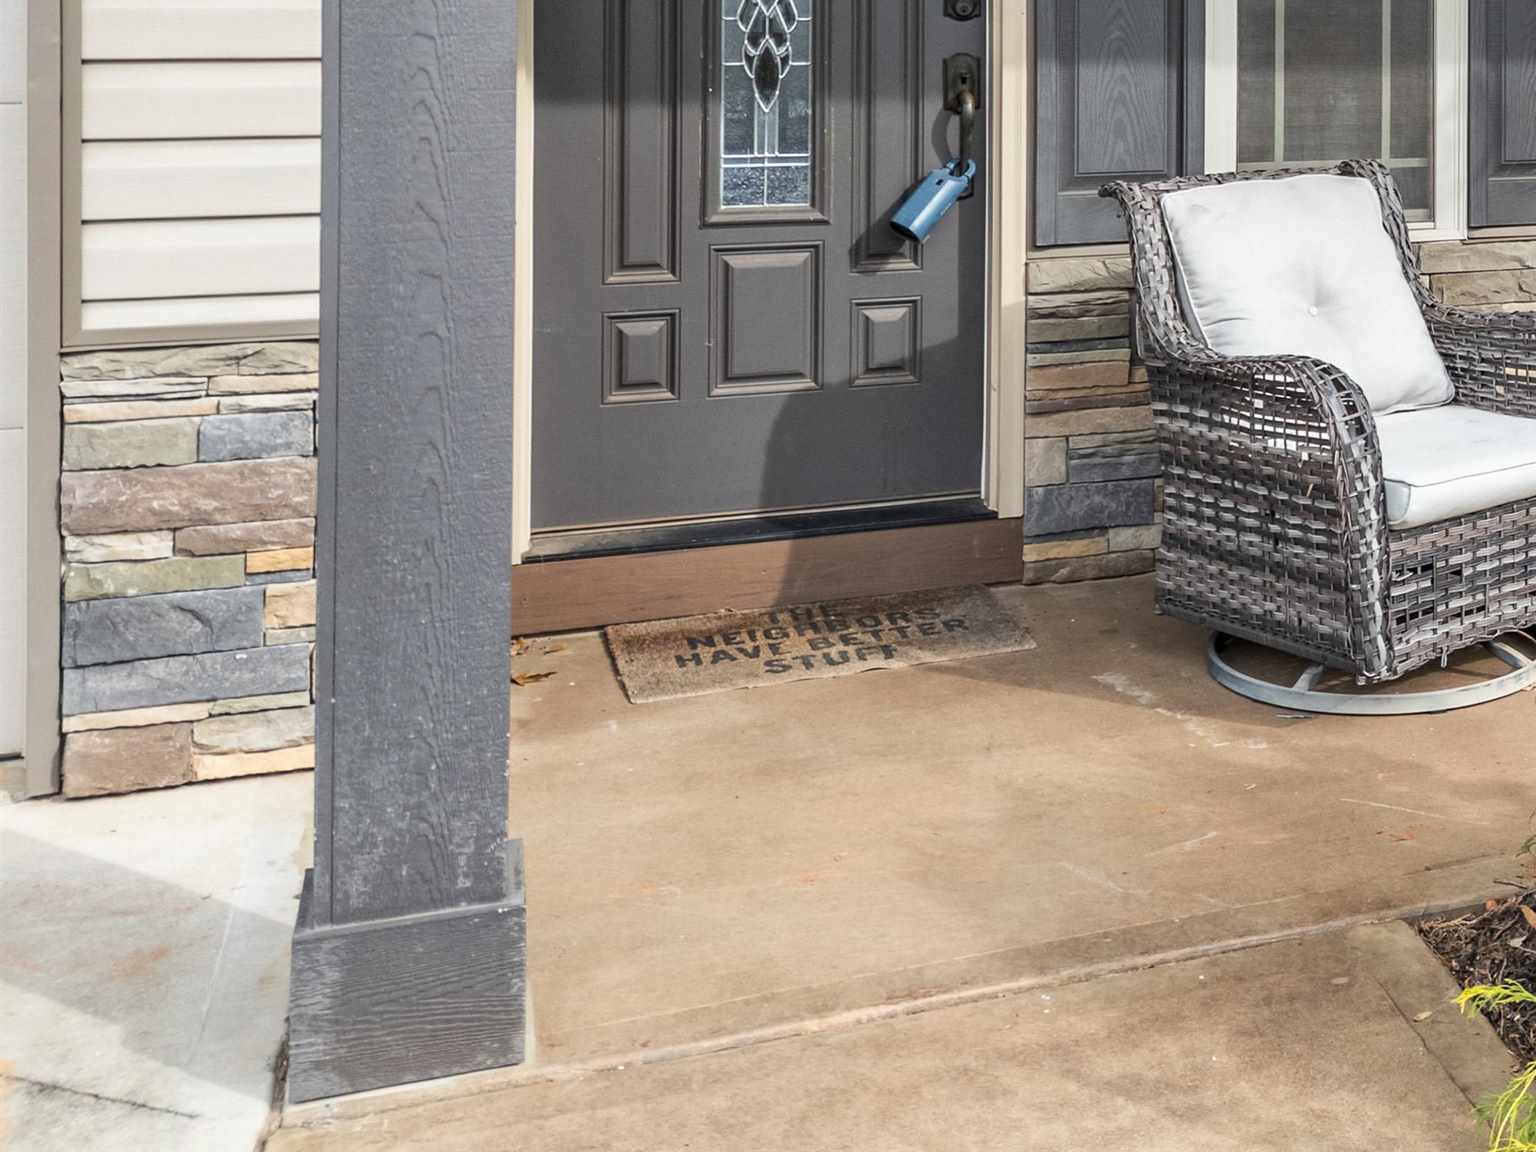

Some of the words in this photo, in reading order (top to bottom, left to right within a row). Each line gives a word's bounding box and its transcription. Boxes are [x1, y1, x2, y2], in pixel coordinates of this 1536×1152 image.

[674, 643, 791, 668] HAVE
[809, 619, 969, 651] BETTER
[685, 608, 941, 650] NEIGHBORS
[764, 644, 898, 673] STUFF
